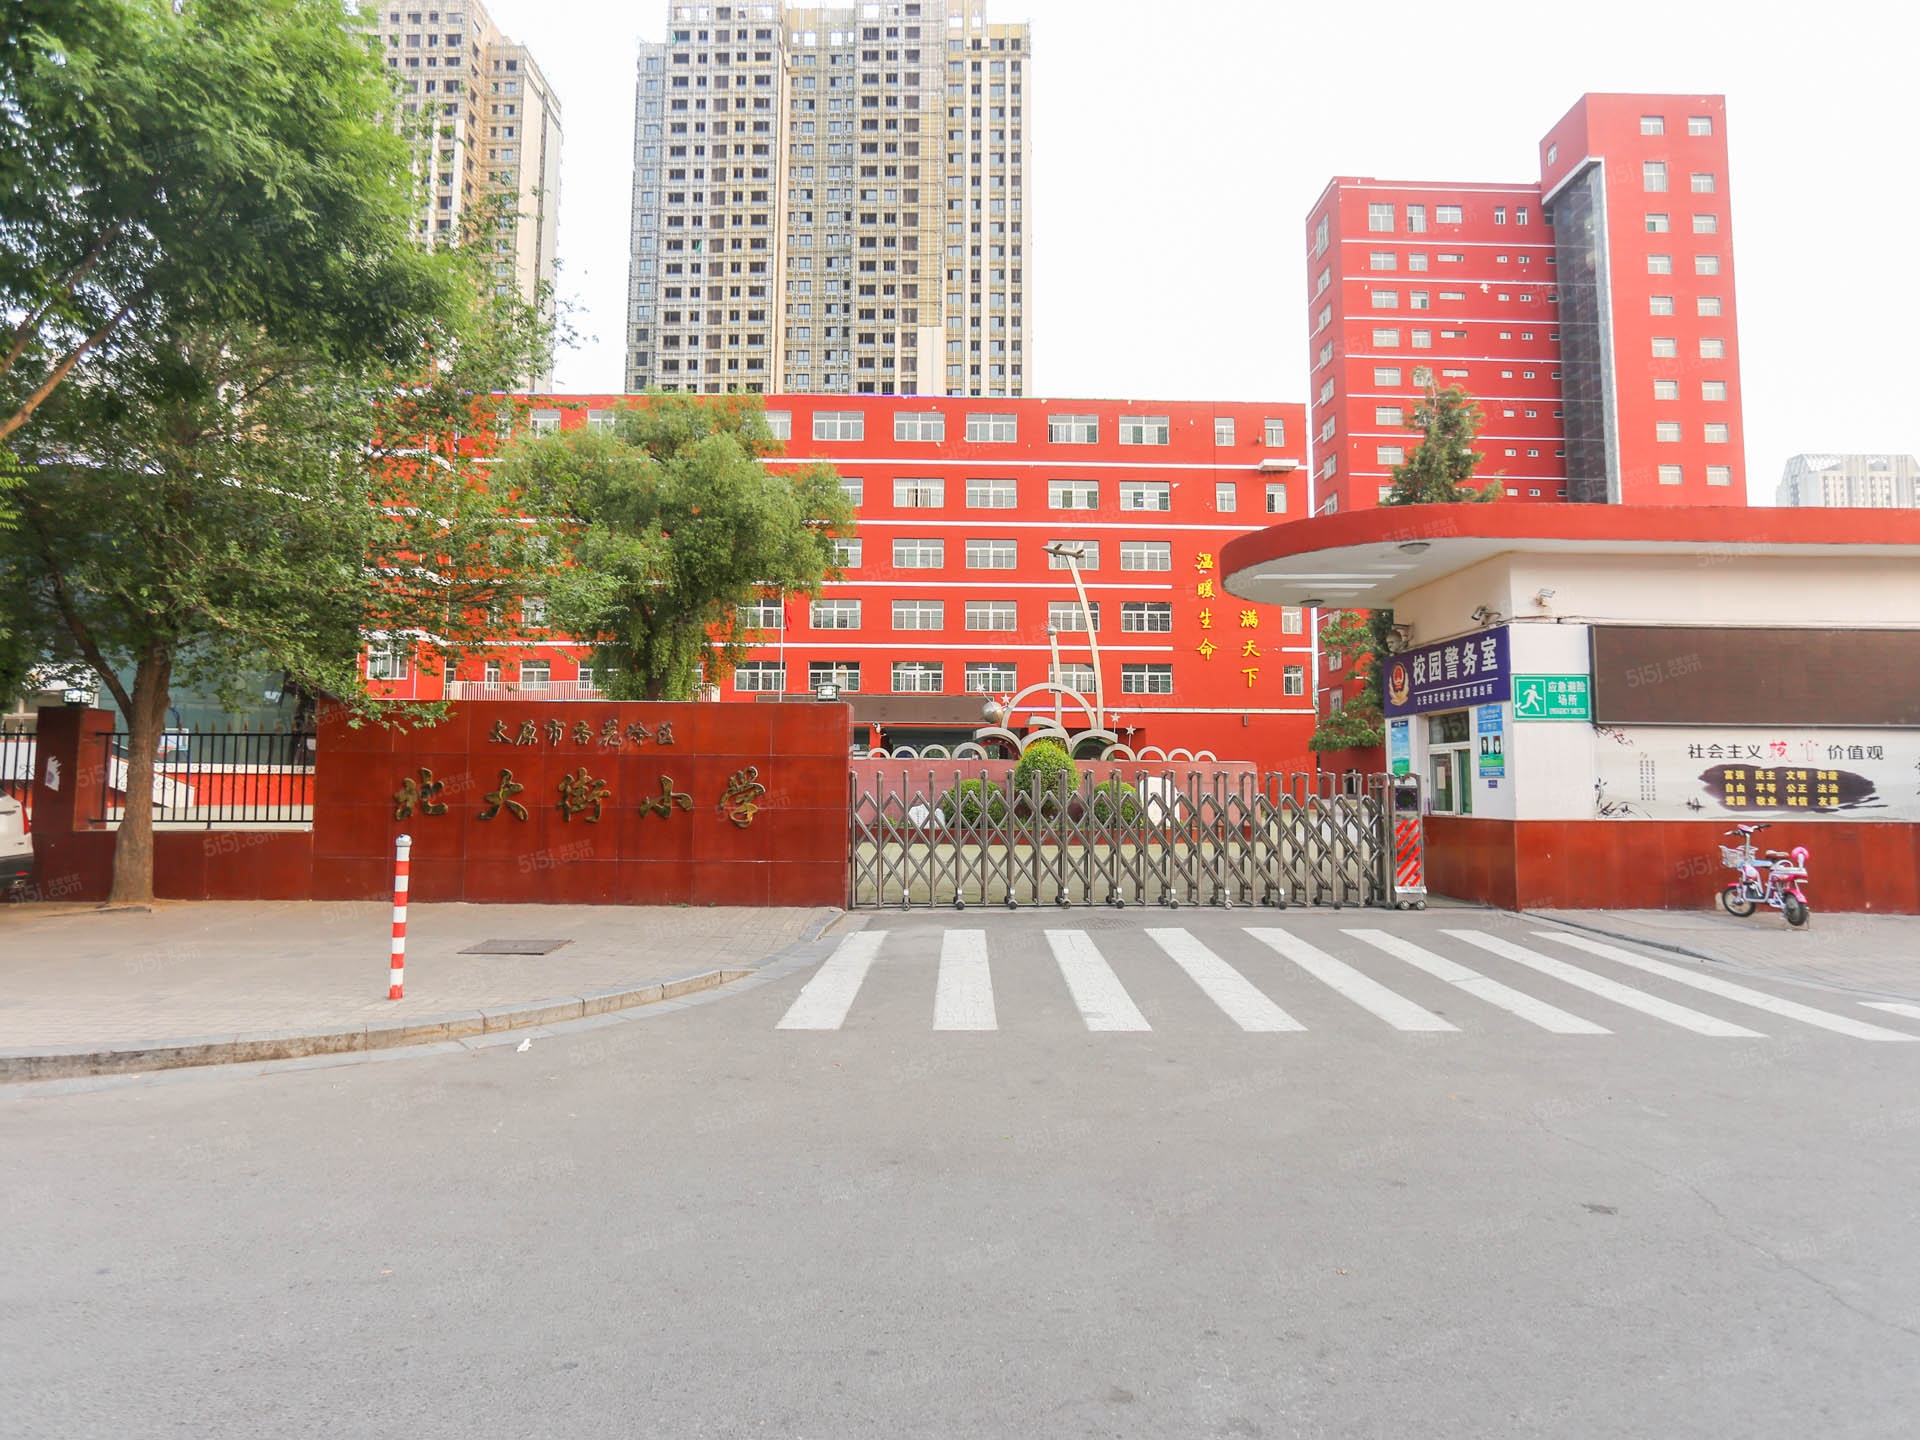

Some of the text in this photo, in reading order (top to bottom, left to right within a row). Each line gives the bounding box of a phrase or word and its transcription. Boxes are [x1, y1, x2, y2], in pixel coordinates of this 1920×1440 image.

[1195, 552, 1219, 661] 温暖生命
[1239, 609, 1261, 688] 满天下
[1412, 636, 1499, 687] 校园警务室
[1557, 694, 1578, 706] 场所
[1723, 769, 1838, 781] 富强 民主 文明 和谐
[1725, 783, 1839, 793] 自由 平等 公正 法治
[392, 765, 767, 830] 北大街小学
[1725, 796, 1839, 807] 爱国 敬业 诚信 友善
